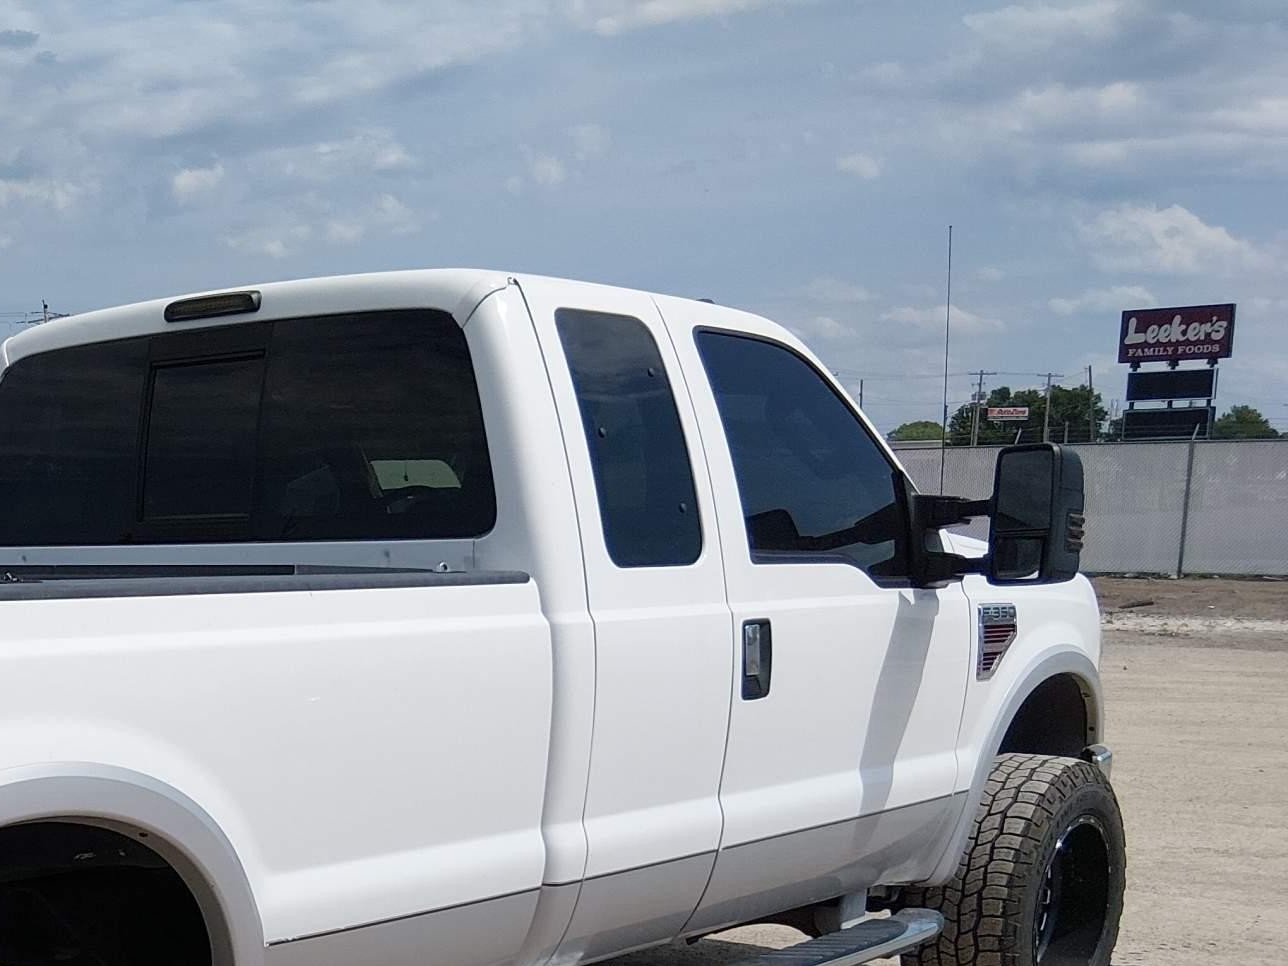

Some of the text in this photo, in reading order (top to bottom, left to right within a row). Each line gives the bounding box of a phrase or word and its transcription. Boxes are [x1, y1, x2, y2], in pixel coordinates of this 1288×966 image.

[1124, 315, 1228, 345] Leeker's
[1128, 344, 1220, 357] FAMILY FOODS
